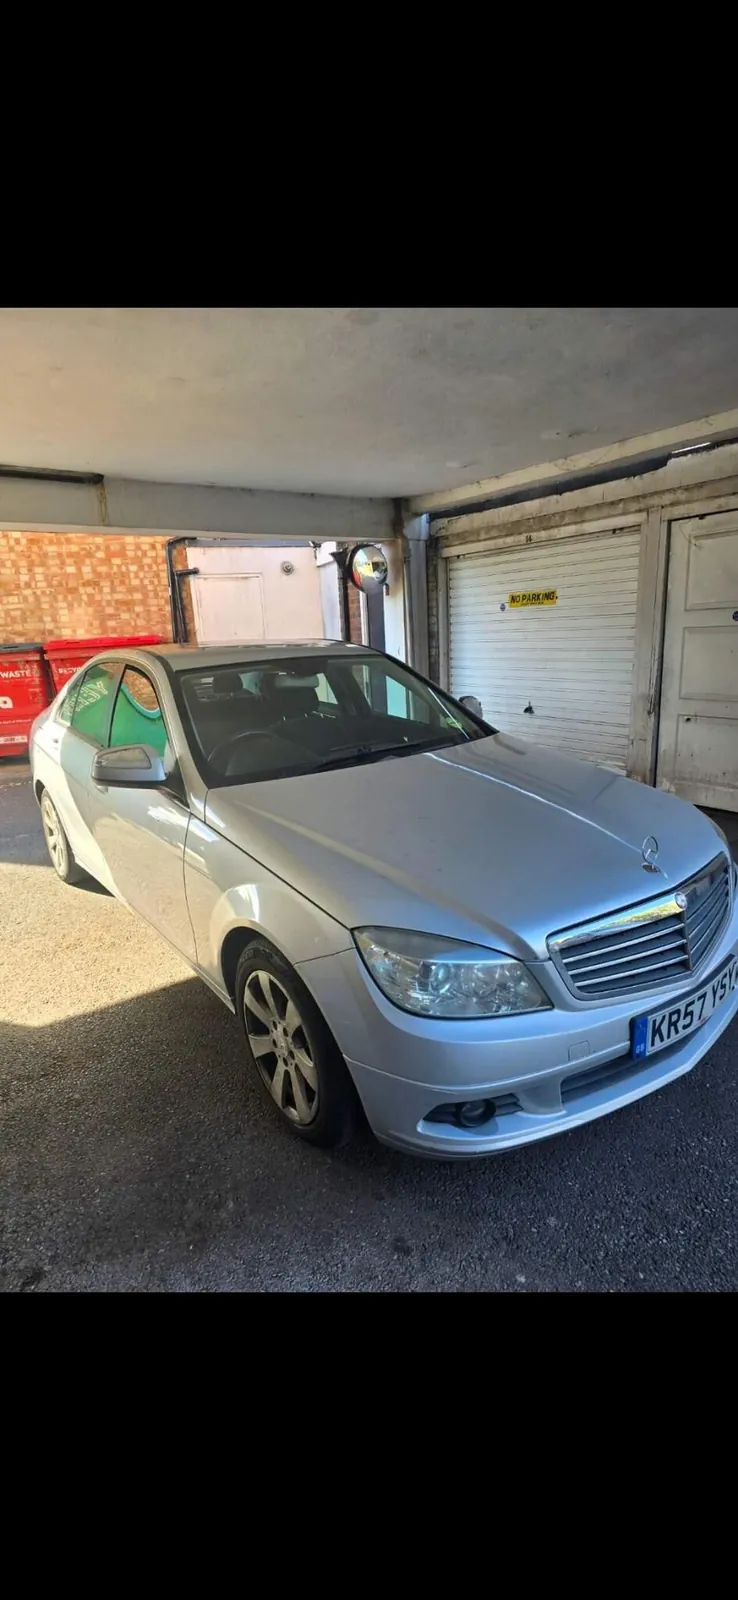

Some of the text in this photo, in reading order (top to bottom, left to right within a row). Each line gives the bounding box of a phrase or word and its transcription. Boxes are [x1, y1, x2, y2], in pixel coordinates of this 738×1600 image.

[510, 594, 521, 604] NO
[522, 591, 555, 603] PARKING
[0, 670, 31, 678] WASTE
[651, 992, 707, 1048] KR57
